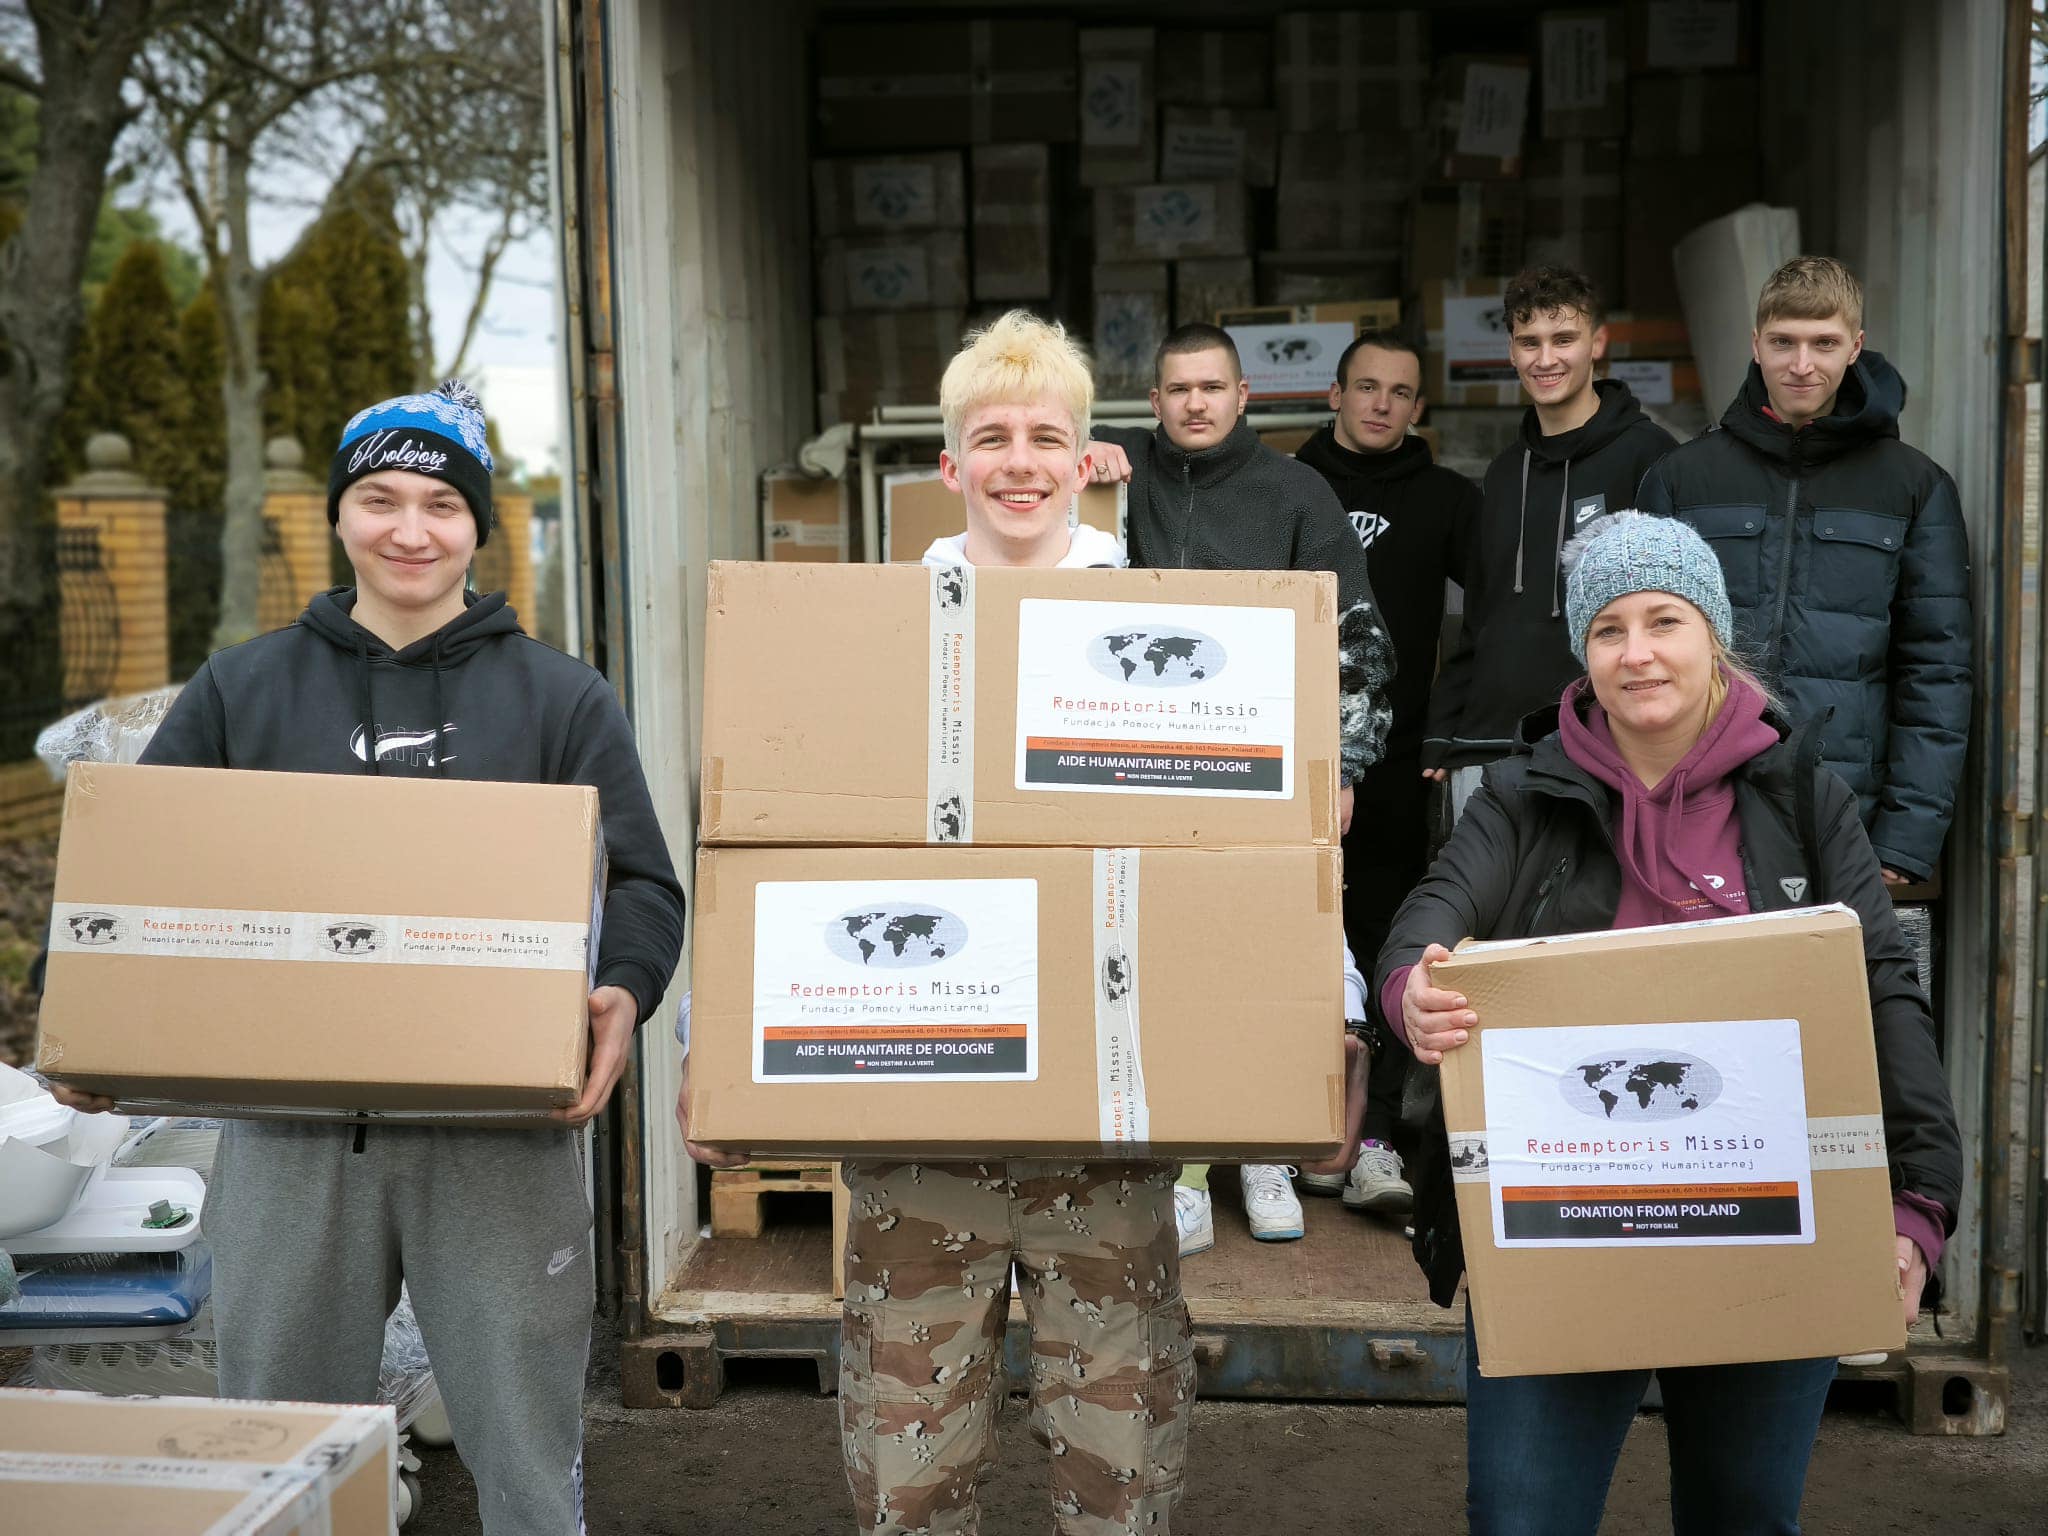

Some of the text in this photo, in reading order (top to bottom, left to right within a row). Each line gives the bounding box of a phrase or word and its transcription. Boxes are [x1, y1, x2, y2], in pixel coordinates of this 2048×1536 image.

[347, 428, 448, 473] Kolejorz
[940, 633, 950, 764] Fundacja Pomocy Humanitarnej
[952, 633, 963, 764] Redemptoris Missio
[1053, 696, 1258, 717] Redemptoris Missio
[1063, 717, 1248, 734] Fundacja Pomocy Humanitarnej
[1057, 755, 1252, 773] AIDE HUMANITAIRE DE POLOGNE
[1119, 856, 1127, 884] Pomocy
[143, 918, 291, 935] Redemptoris Missio
[141, 935, 201, 945] Humanitarian
[224, 940, 274, 948] Foundation
[404, 928, 550, 944] Redemptoris Missio
[403, 943, 549, 957] Fundacja Pomocy Humanitarnej
[791, 981, 1001, 999] Redemptoris Missio
[801, 1003, 990, 1015] Fundacja Pomocy Humanitarnej
[795, 1042, 994, 1056] AIDE HUMANITAIRE DE POLOGNE
[1110, 1036, 1119, 1082] Missio
[1527, 1135, 1765, 1156] Redemptoris Missio
[1811, 1144, 1855, 1156] Missi
[1541, 1159, 1754, 1172] Fundacja Pomocy Humanitarnej
[1559, 1203, 1741, 1218] DONATION FROM POLAND
